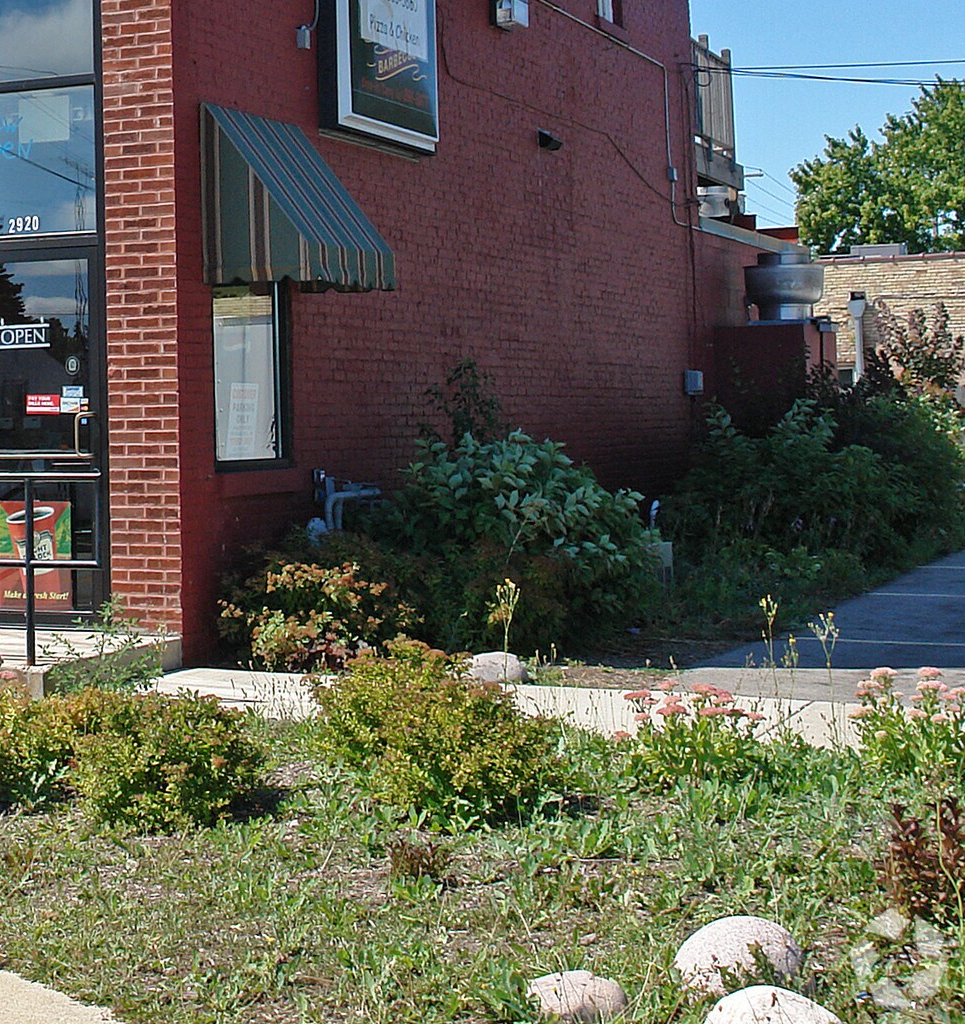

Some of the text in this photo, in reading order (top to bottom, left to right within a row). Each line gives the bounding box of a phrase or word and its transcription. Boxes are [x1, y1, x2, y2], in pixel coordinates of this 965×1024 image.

[369, 13, 388, 35] Pizza
[8, 215, 40, 234] 2920
[0, 328, 46, 345] OPEN
[3, 590, 22, 600] Make
[33, 590, 48, 600] resh
[49, 590, 70, 601] Start!
